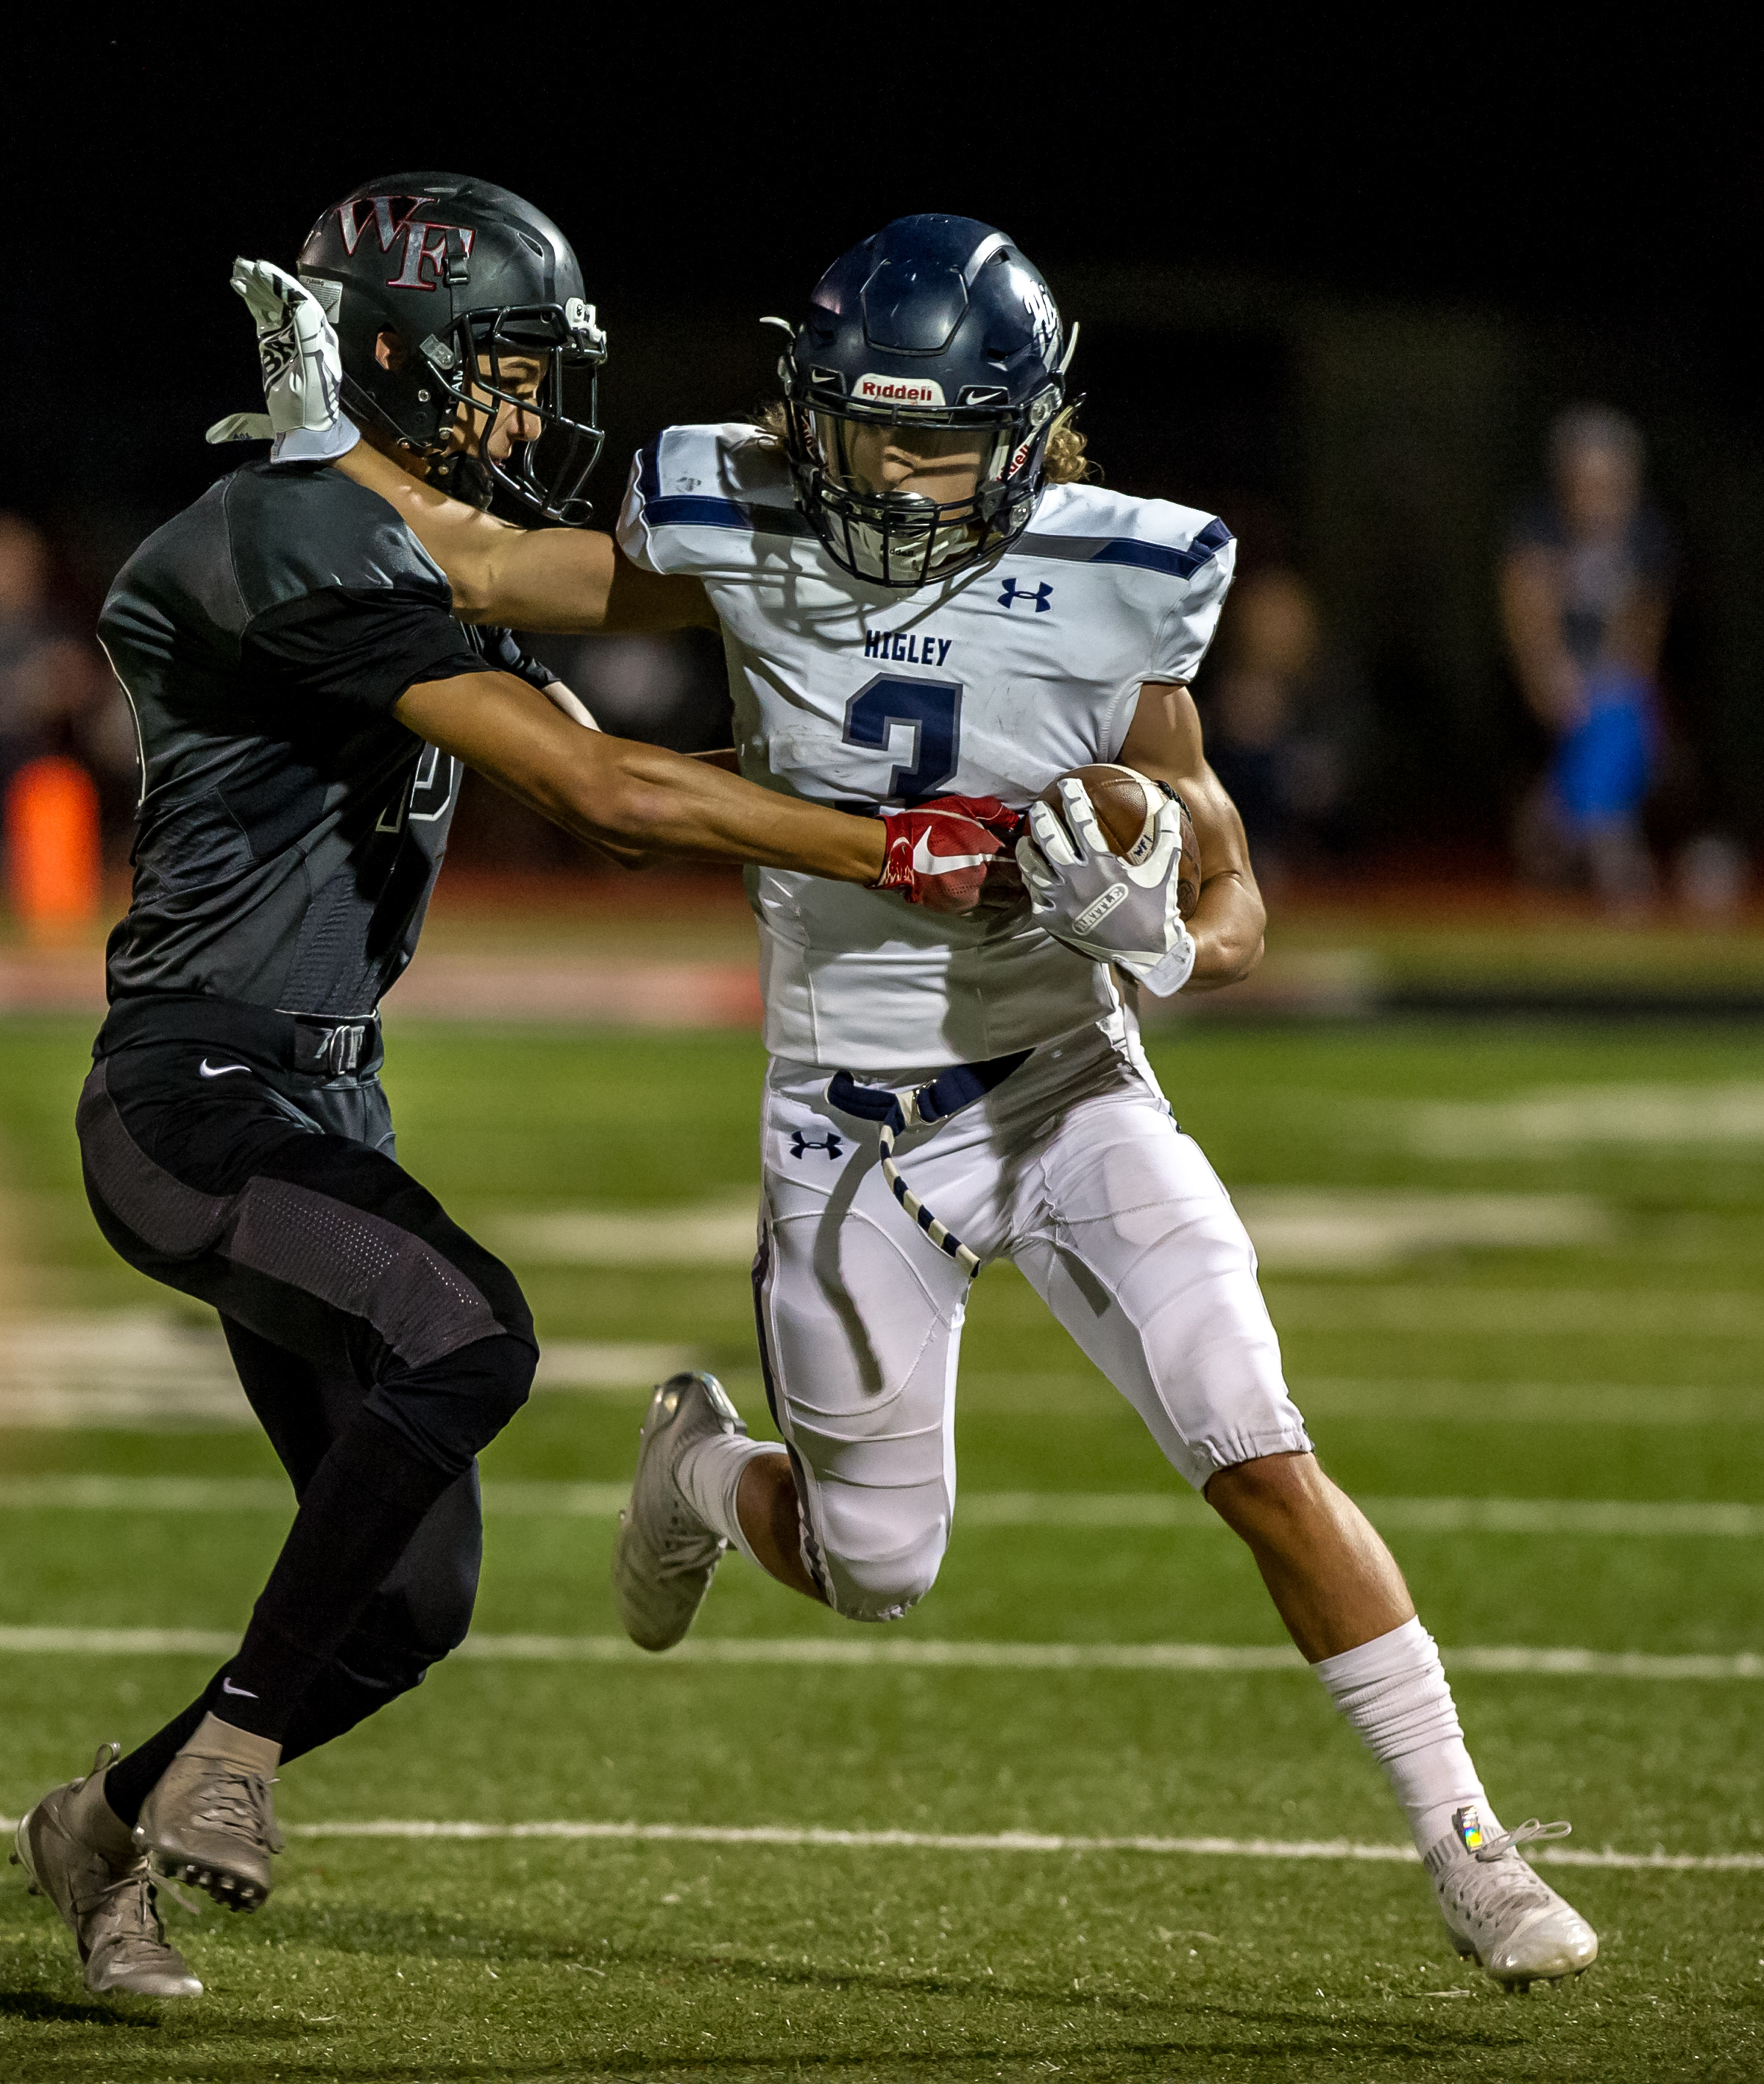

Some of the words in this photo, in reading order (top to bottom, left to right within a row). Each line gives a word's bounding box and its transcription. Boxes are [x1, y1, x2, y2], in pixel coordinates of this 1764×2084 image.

[862, 381, 932, 401] Riddell
[864, 629, 952, 667] HIGLEY
[1074, 887, 1124, 932] BATTLE
